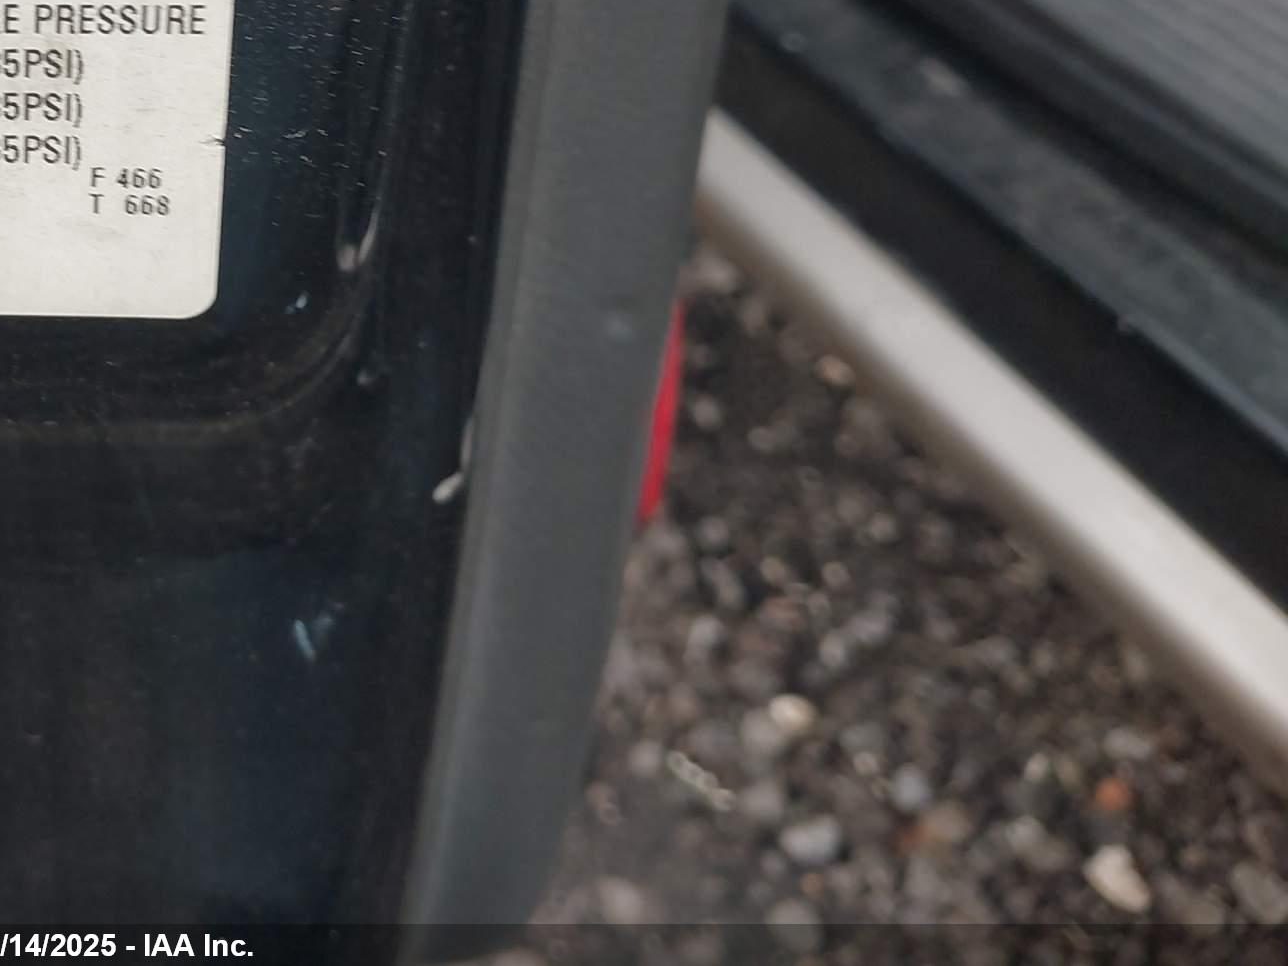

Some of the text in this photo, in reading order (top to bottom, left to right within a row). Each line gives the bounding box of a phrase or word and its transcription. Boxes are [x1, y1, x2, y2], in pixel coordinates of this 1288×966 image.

[35, 3, 206, 36] PRESSURE
[89, 166, 163, 189] F 466
[88, 193, 170, 216] T 668
